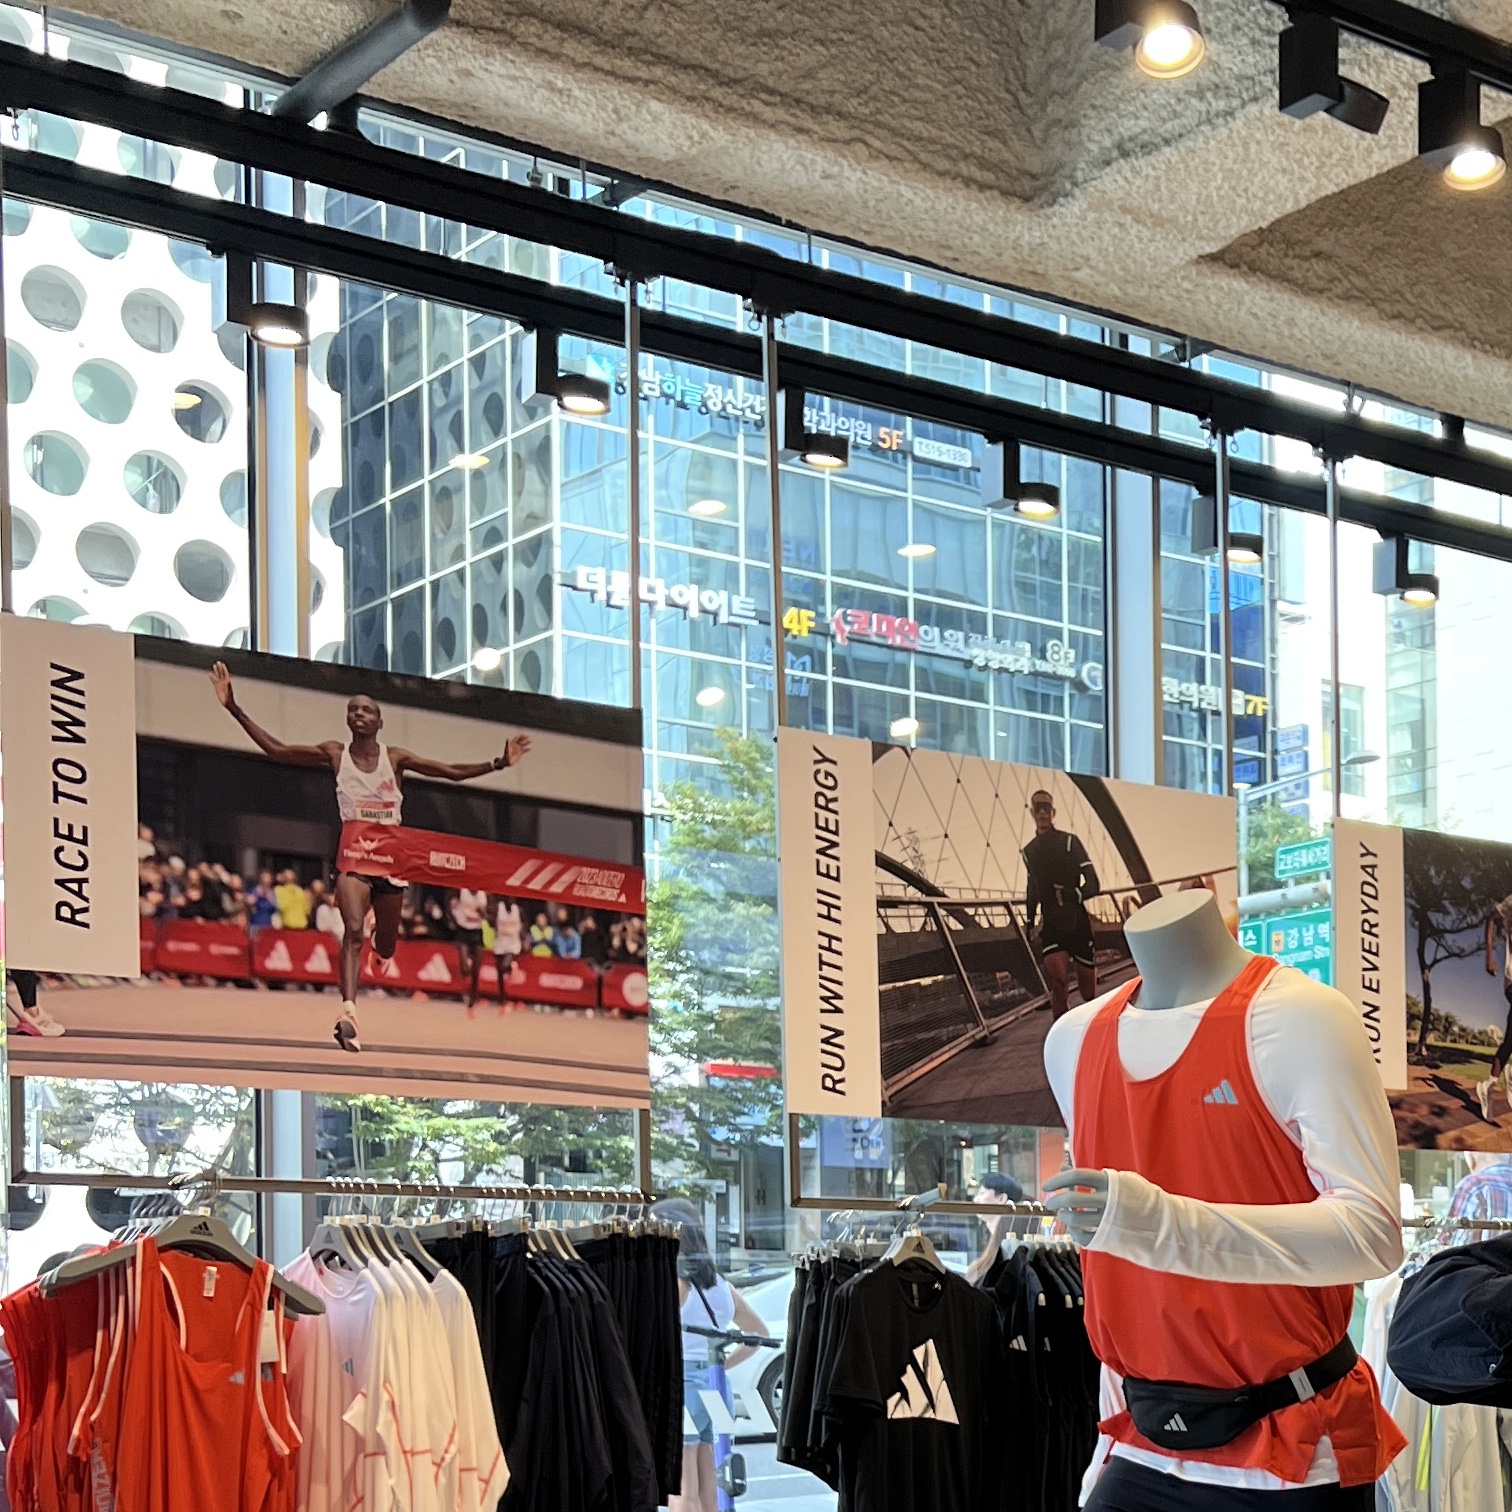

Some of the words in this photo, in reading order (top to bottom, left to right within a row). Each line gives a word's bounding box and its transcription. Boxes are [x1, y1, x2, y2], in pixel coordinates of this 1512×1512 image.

[878, 426, 904, 450] 5F
[782, 606, 816, 637] 4F
[49, 661, 87, 745] WIN
[1244, 694, 1270, 717] 7F
[52, 757, 89, 806] TO
[812, 744, 842, 884] ENERGY
[53, 816, 91, 930] RACE
[816, 889, 842, 925] HI
[1286, 921, 1330, 950] 강남역
[1359, 840, 1381, 995] EVERYDAY
[818, 929, 845, 1015] WITH
[820, 1023, 847, 1097] RUN
